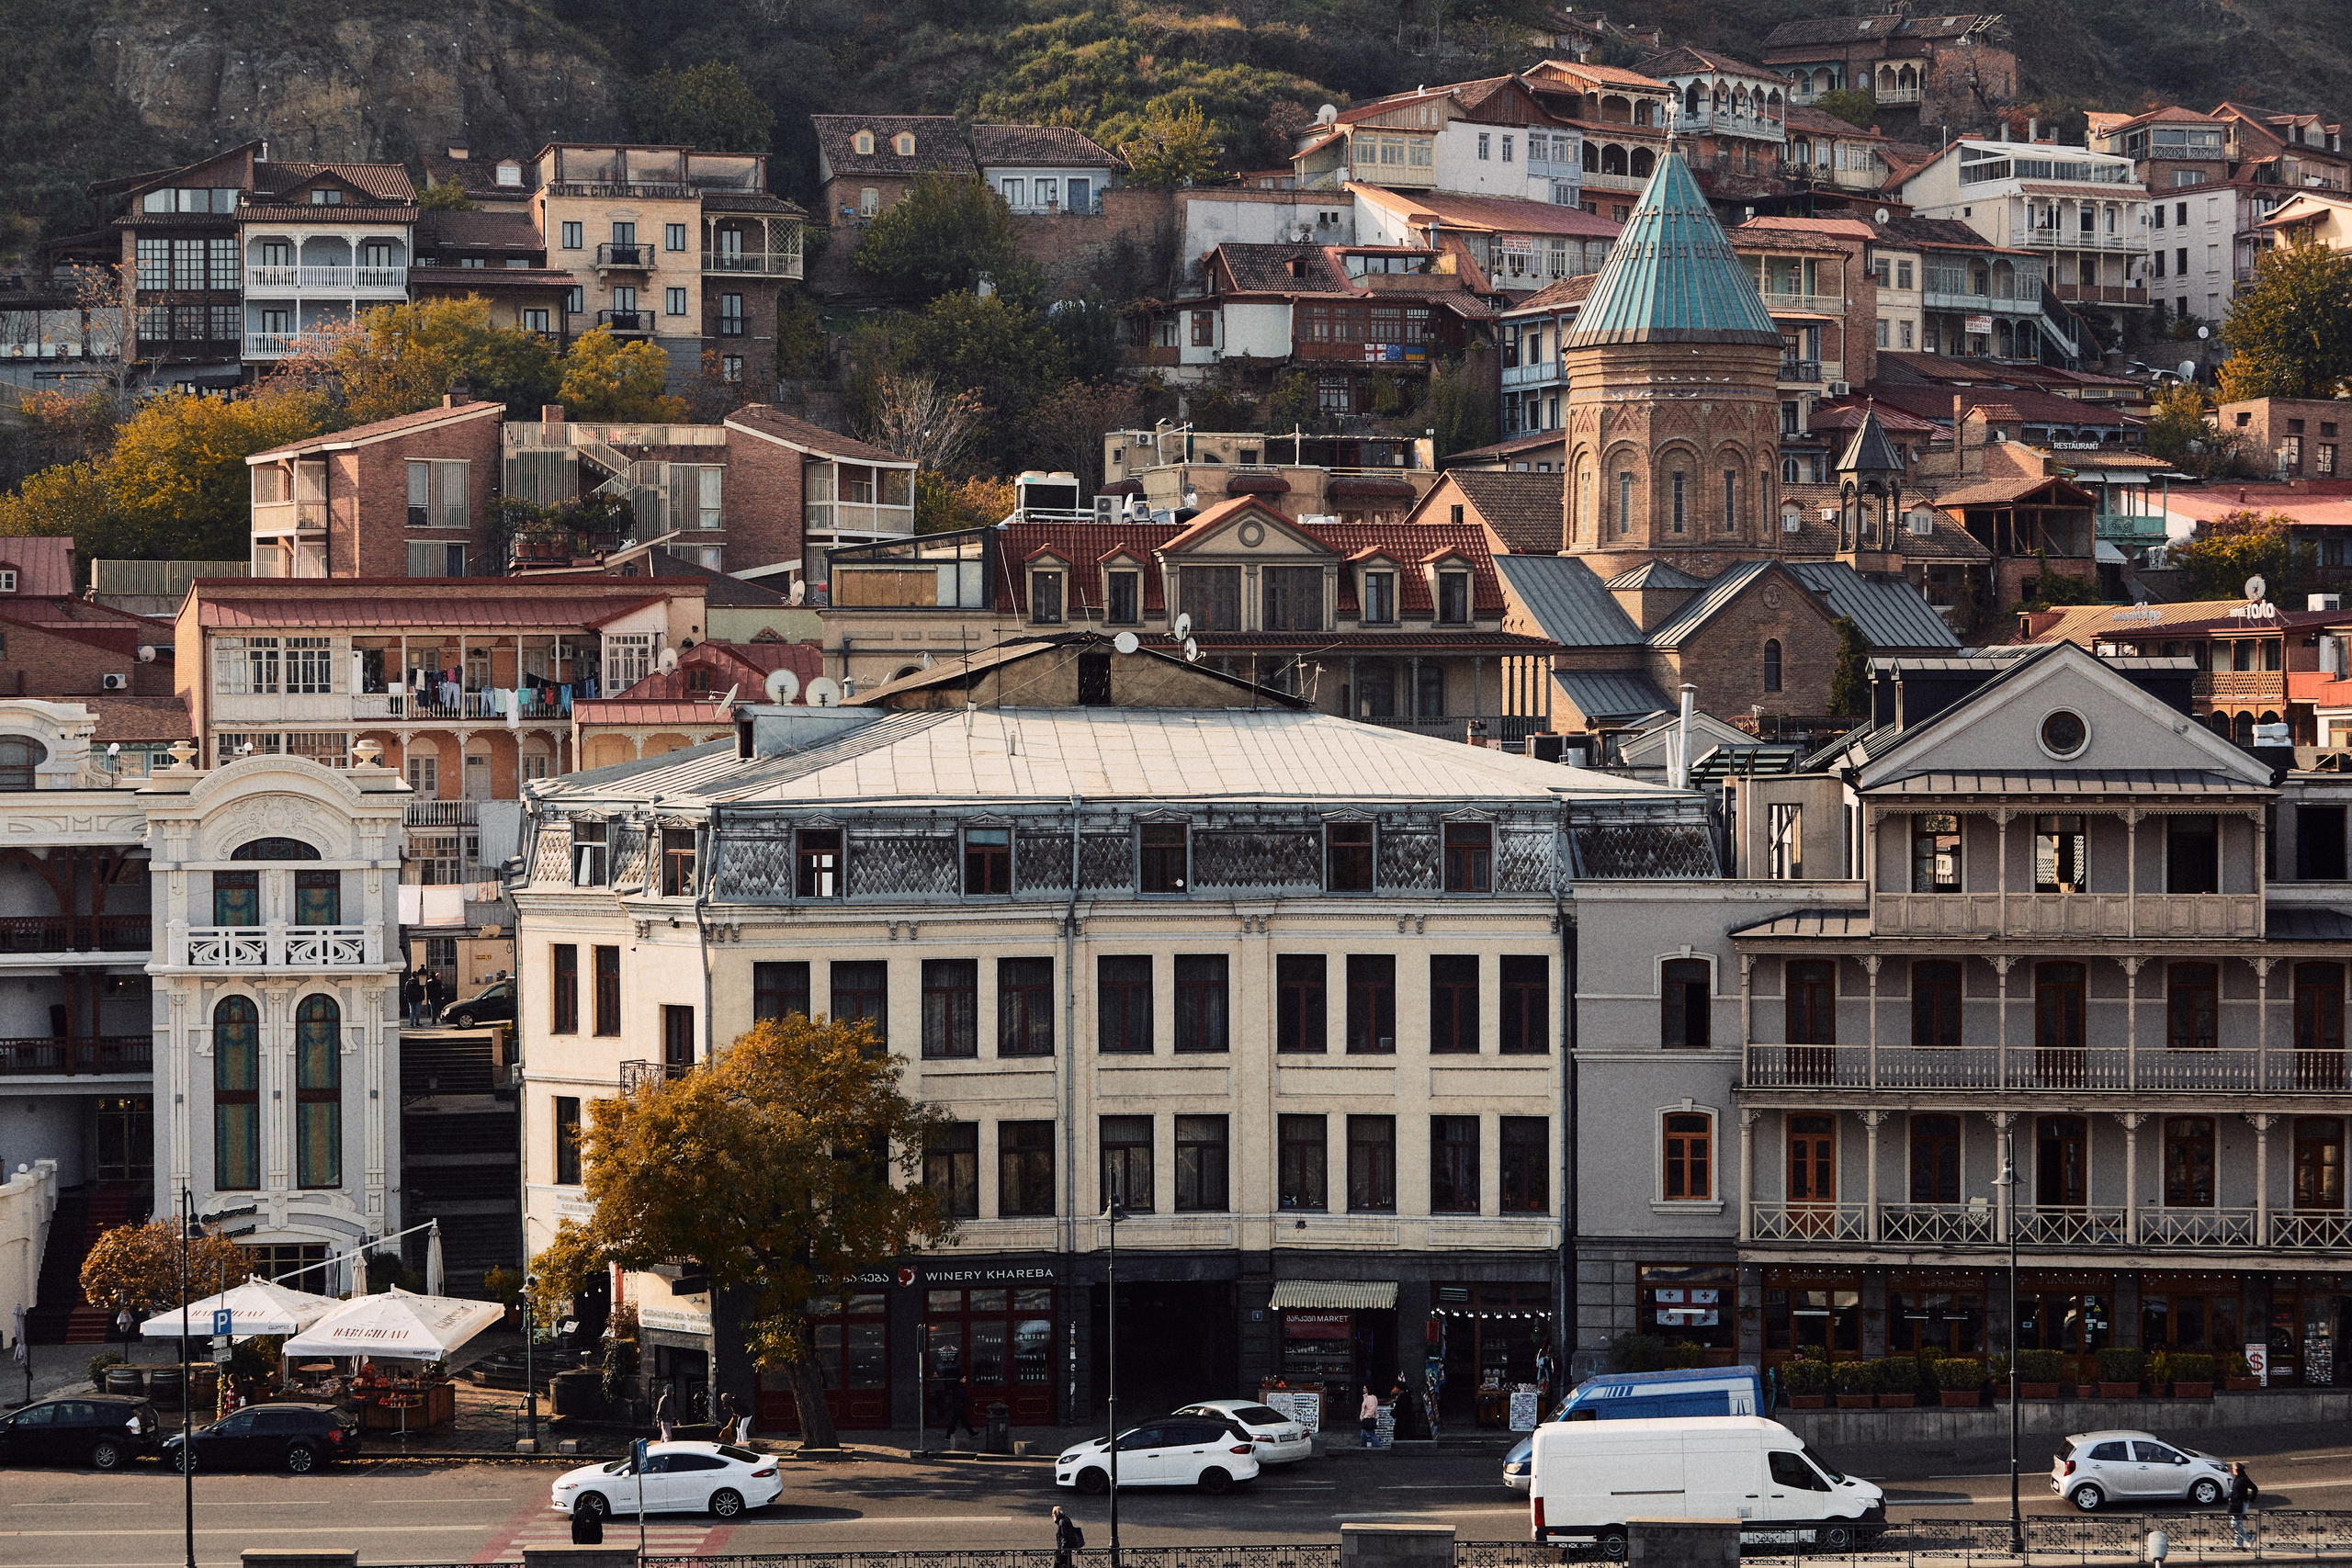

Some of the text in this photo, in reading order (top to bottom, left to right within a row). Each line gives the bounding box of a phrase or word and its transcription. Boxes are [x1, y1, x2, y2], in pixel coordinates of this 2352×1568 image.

[549, 185, 701, 199] HOTEL CITADEL NARIKALA
[2053, 442, 2099, 450] RESTAURANT
[200, 1204, 257, 1224] Restaurant
[925, 1269, 1054, 1280] WINERY KHAREBA
[2196, 1281, 2238, 1291] CUISINE
[218, 1313, 228, 1333] P
[1286, 1314, 1316, 1323] მარკეტი
